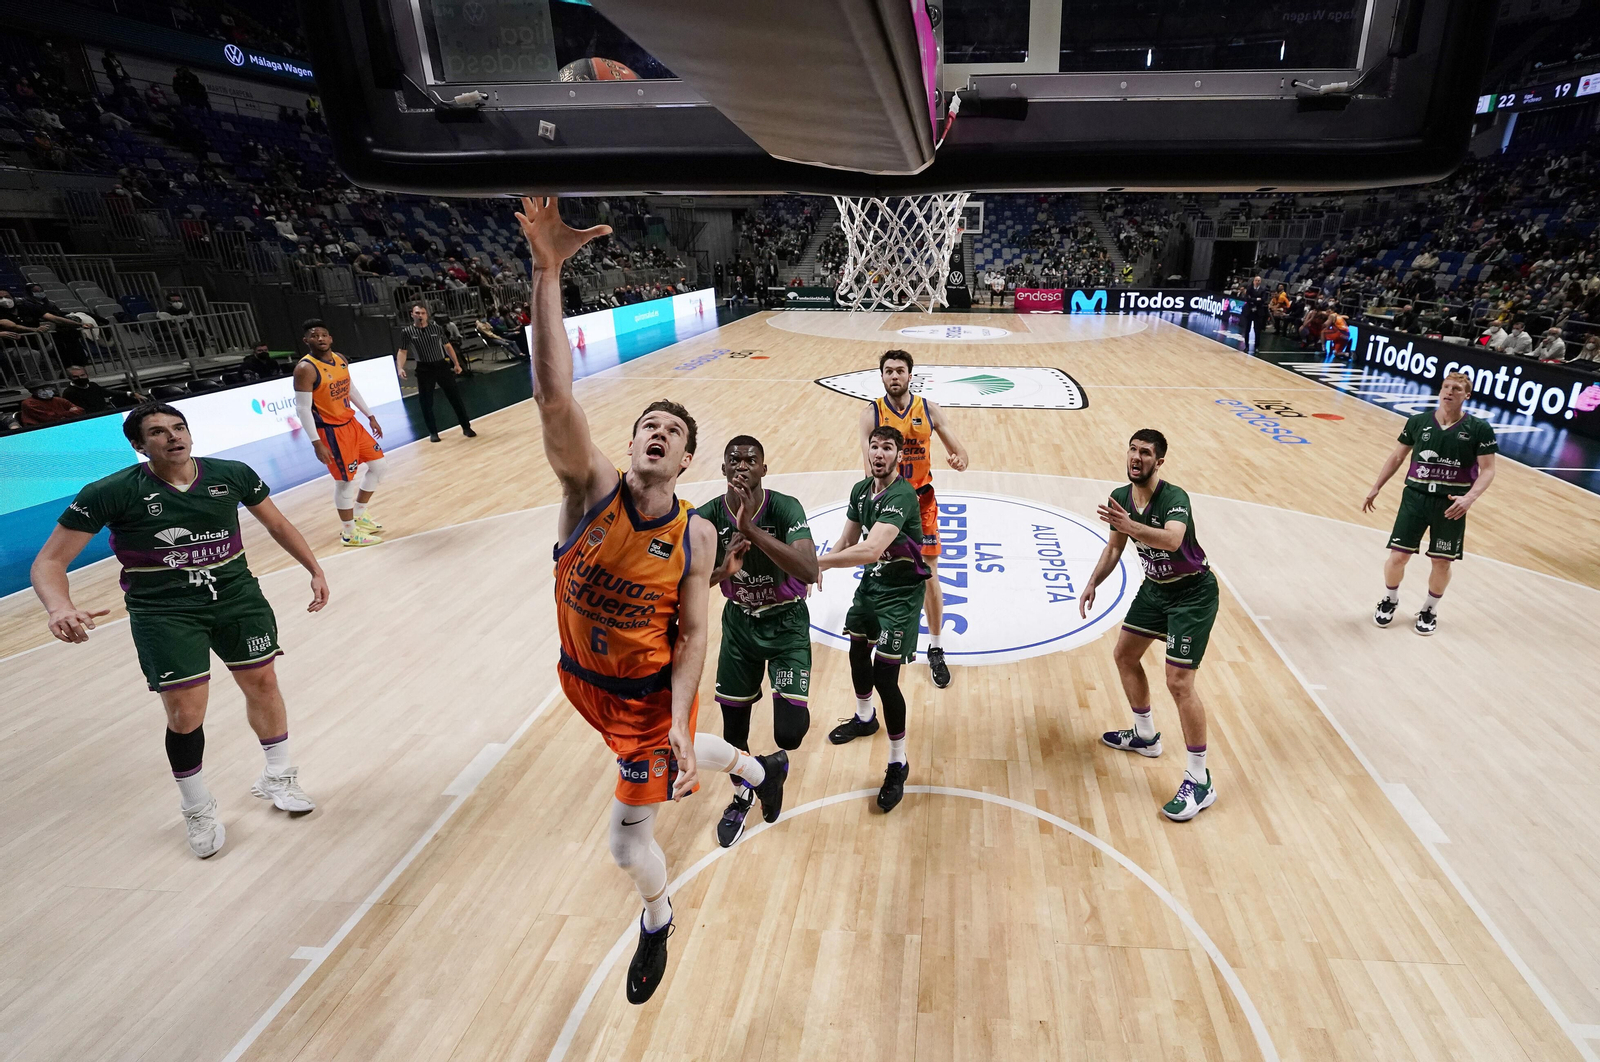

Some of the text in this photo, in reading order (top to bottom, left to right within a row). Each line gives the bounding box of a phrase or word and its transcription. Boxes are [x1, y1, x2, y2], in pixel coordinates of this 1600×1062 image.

[249, 54, 313, 77] Málaga Wagen
[1498, 93, 1516, 109] 22
[1555, 82, 1572, 98] 19
[1016, 290, 1062, 301] endesa
[1189, 292, 1225, 316] contigo!
[1253, 399, 1308, 418] liga
[1215, 398, 1312, 445] endesa
[190, 529, 230, 542] Unicaja
[974, 543, 1005, 574] LAS
[1031, 523, 1077, 603] AUTOPISTA
[576, 551, 646, 599] ultura
[566, 577, 657, 618] sfuerzo
[590, 626, 609, 656] 6
